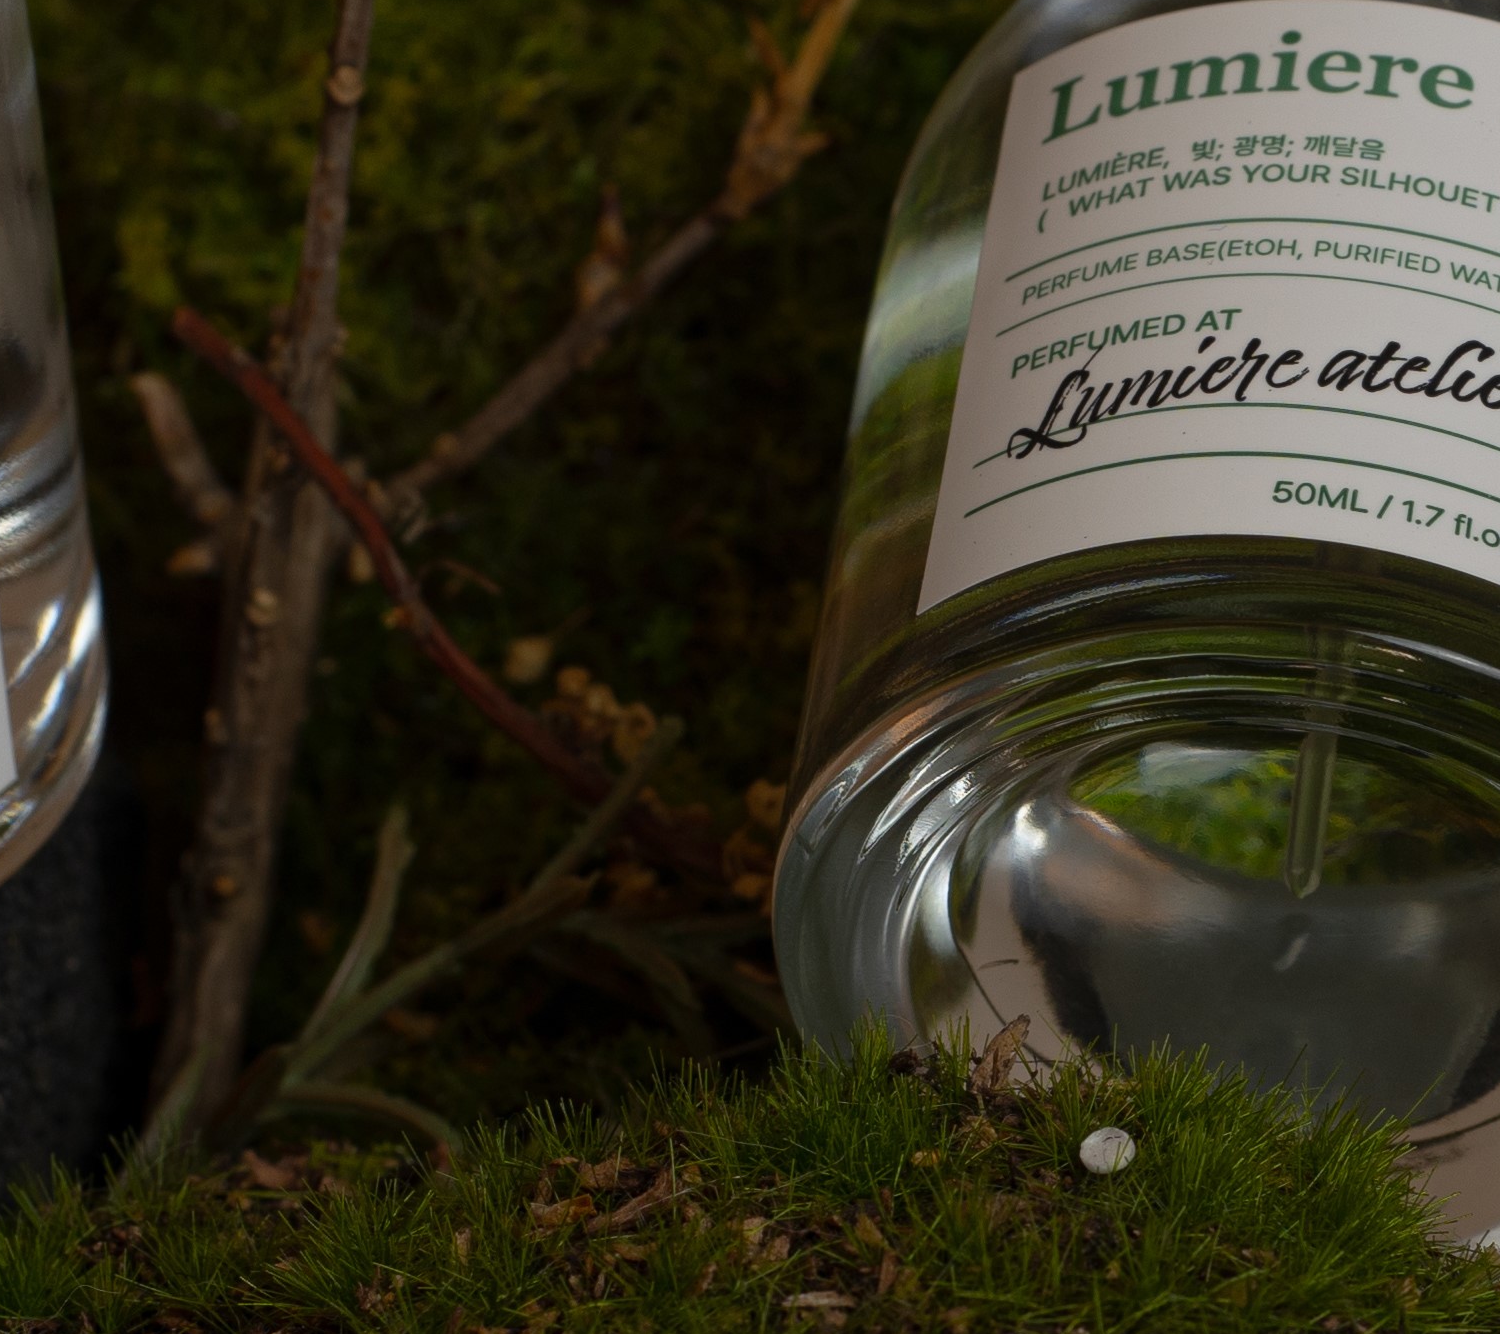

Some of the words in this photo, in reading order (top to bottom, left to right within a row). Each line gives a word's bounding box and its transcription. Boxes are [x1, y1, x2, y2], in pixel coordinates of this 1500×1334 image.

[1041, 29, 1476, 145] Lumiere
[1041, 146, 1170, 202] LUMIÈRE,
[1232, 134, 1294, 158] 광명;
[1303, 134, 1386, 162] 깨달음
[1068, 177, 1154, 218] WHAT
[1163, 165, 1232, 193] WAS
[1241, 162, 1331, 186] YOUR
[1021, 252, 1139, 306] PERFUME
[1313, 239, 1442, 275] PURIFIED
[1010, 311, 1186, 379] PERFUMED
[1194, 308, 1243, 332] AT
[1006, 335, 1310, 459] Lumiere
[1271, 479, 1370, 516] 50ML
[1401, 499, 1445, 529] 1.7
